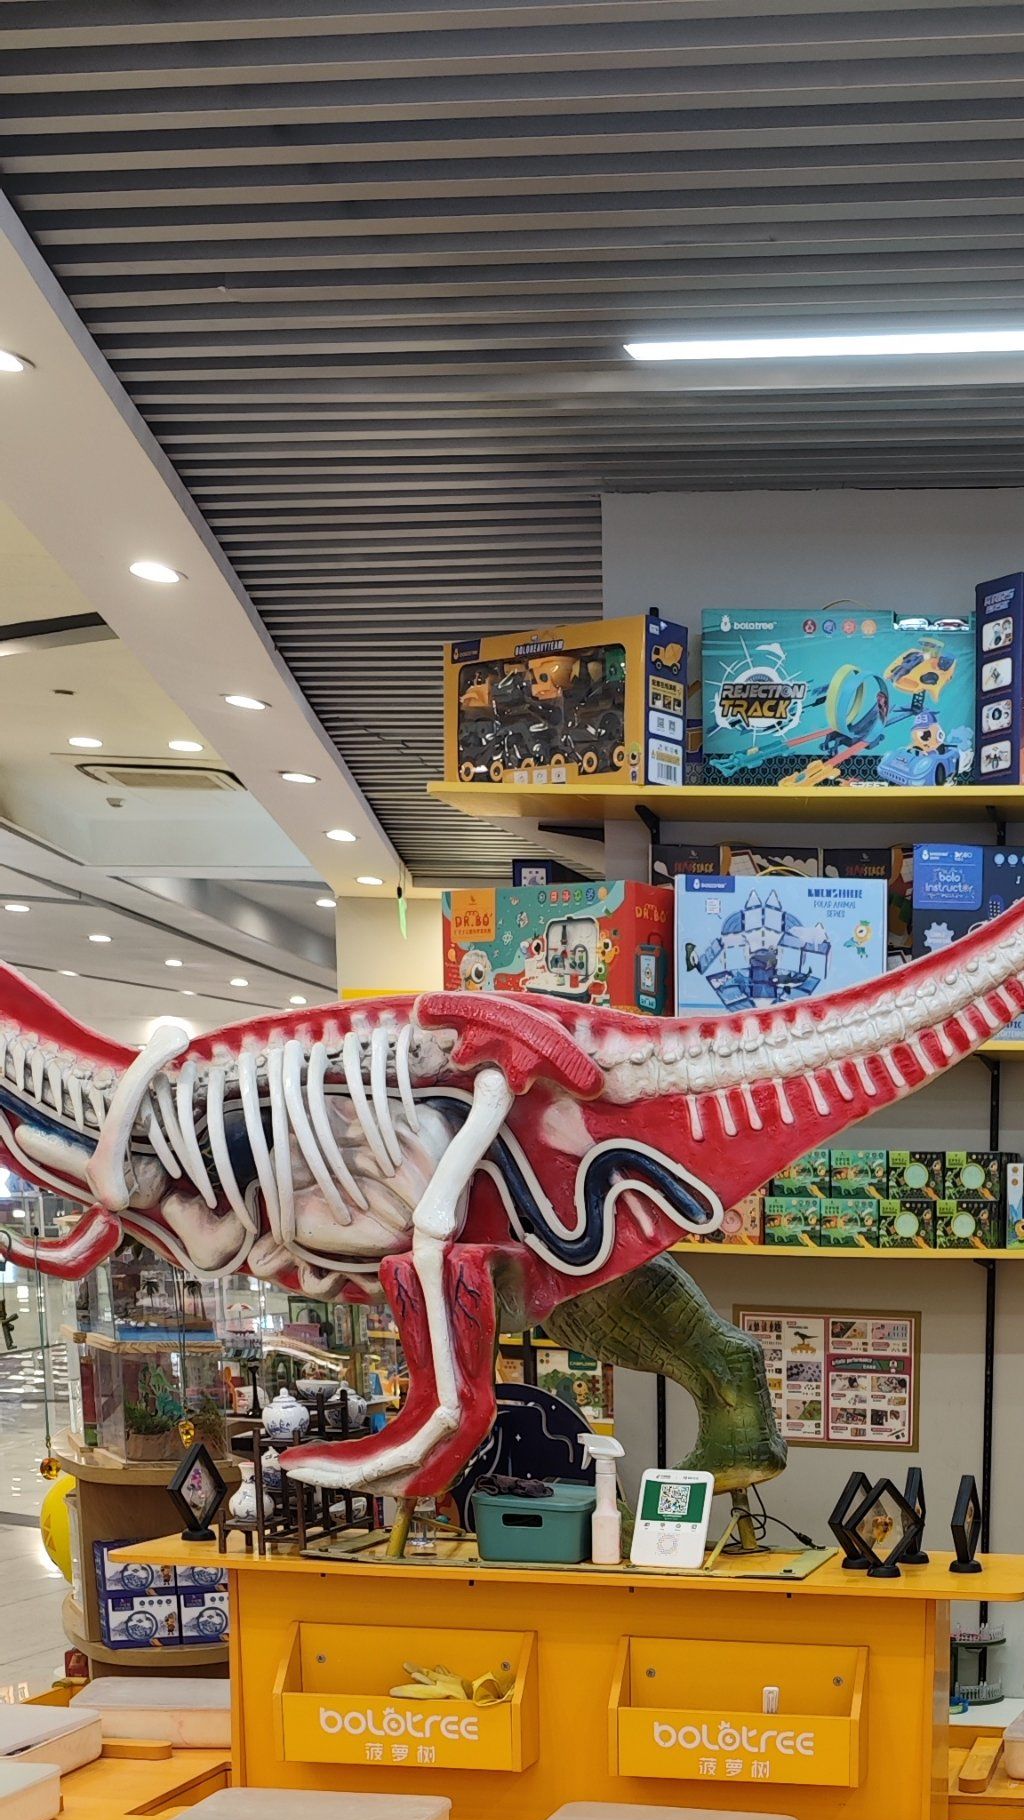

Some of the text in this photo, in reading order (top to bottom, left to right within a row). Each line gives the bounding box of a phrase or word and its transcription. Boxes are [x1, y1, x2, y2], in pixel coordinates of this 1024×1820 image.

[722, 683, 808, 699] REJECTION
[719, 699, 791, 726] TRACK
[938, 871, 961, 882] bolo
[364, 1742, 437, 1764] 菠萝树
[698, 1757, 771, 1779] 菠萝树
